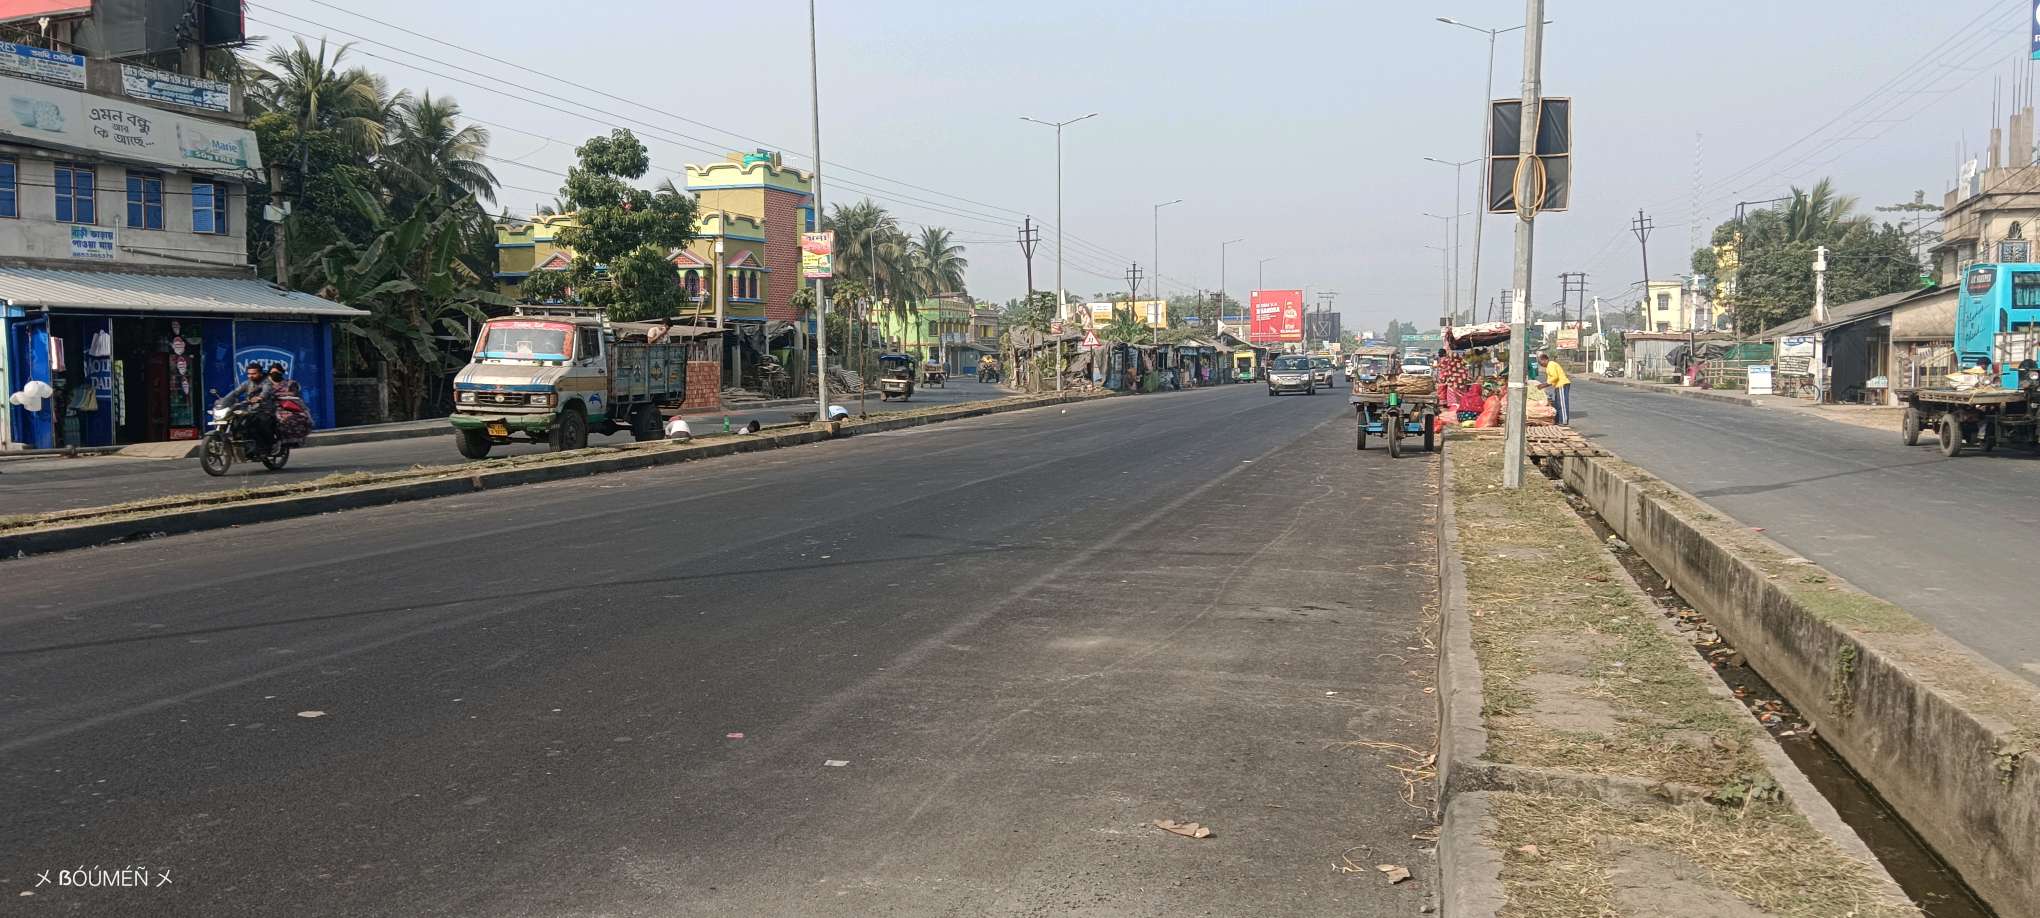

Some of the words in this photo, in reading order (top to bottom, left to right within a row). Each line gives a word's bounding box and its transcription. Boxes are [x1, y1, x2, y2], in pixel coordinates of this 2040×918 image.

[88, 108, 124, 122] এমন
[126, 112, 152, 135] বন্ধু
[112, 123, 129, 134] আর
[93, 124, 109, 139] কে
[211, 139, 238, 153] Marie
